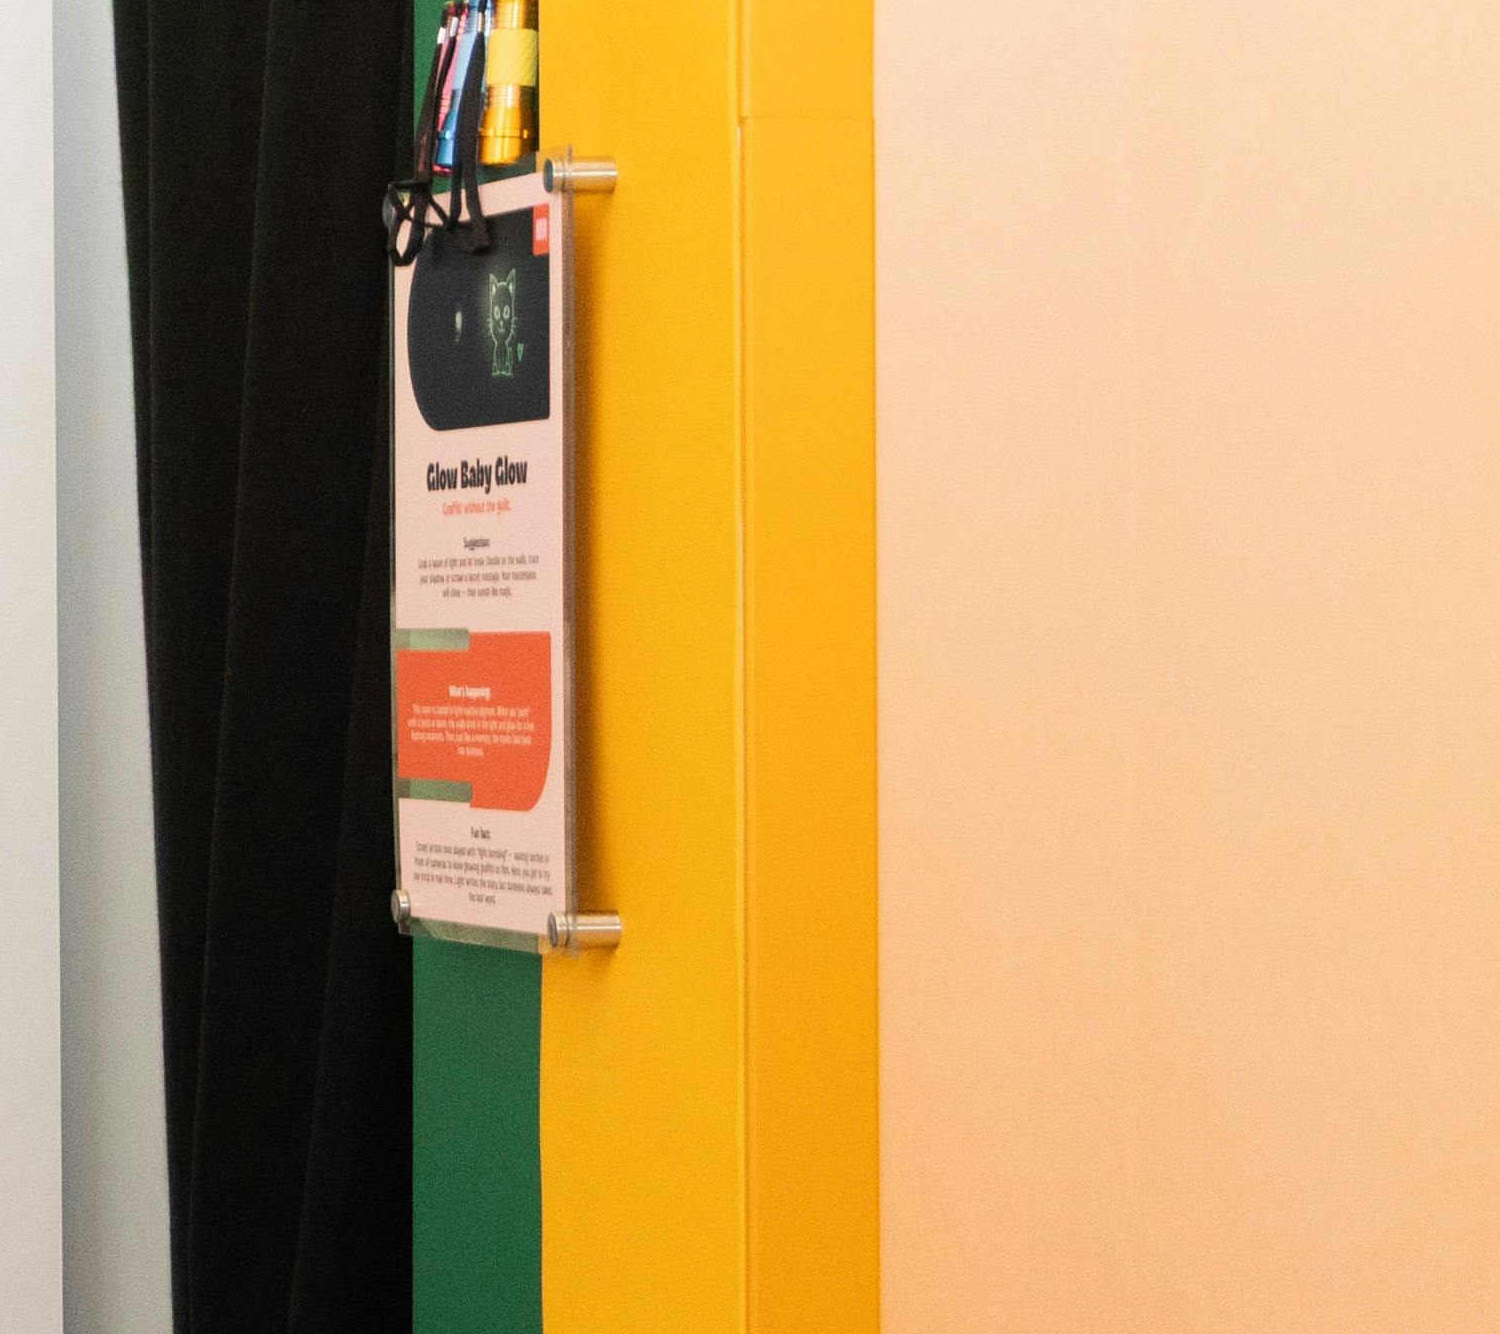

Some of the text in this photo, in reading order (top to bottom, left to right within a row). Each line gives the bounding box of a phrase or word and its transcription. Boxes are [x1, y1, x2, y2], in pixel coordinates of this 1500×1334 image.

[427, 455, 528, 494] Glow Baby Glow
[486, 499, 496, 512] the
